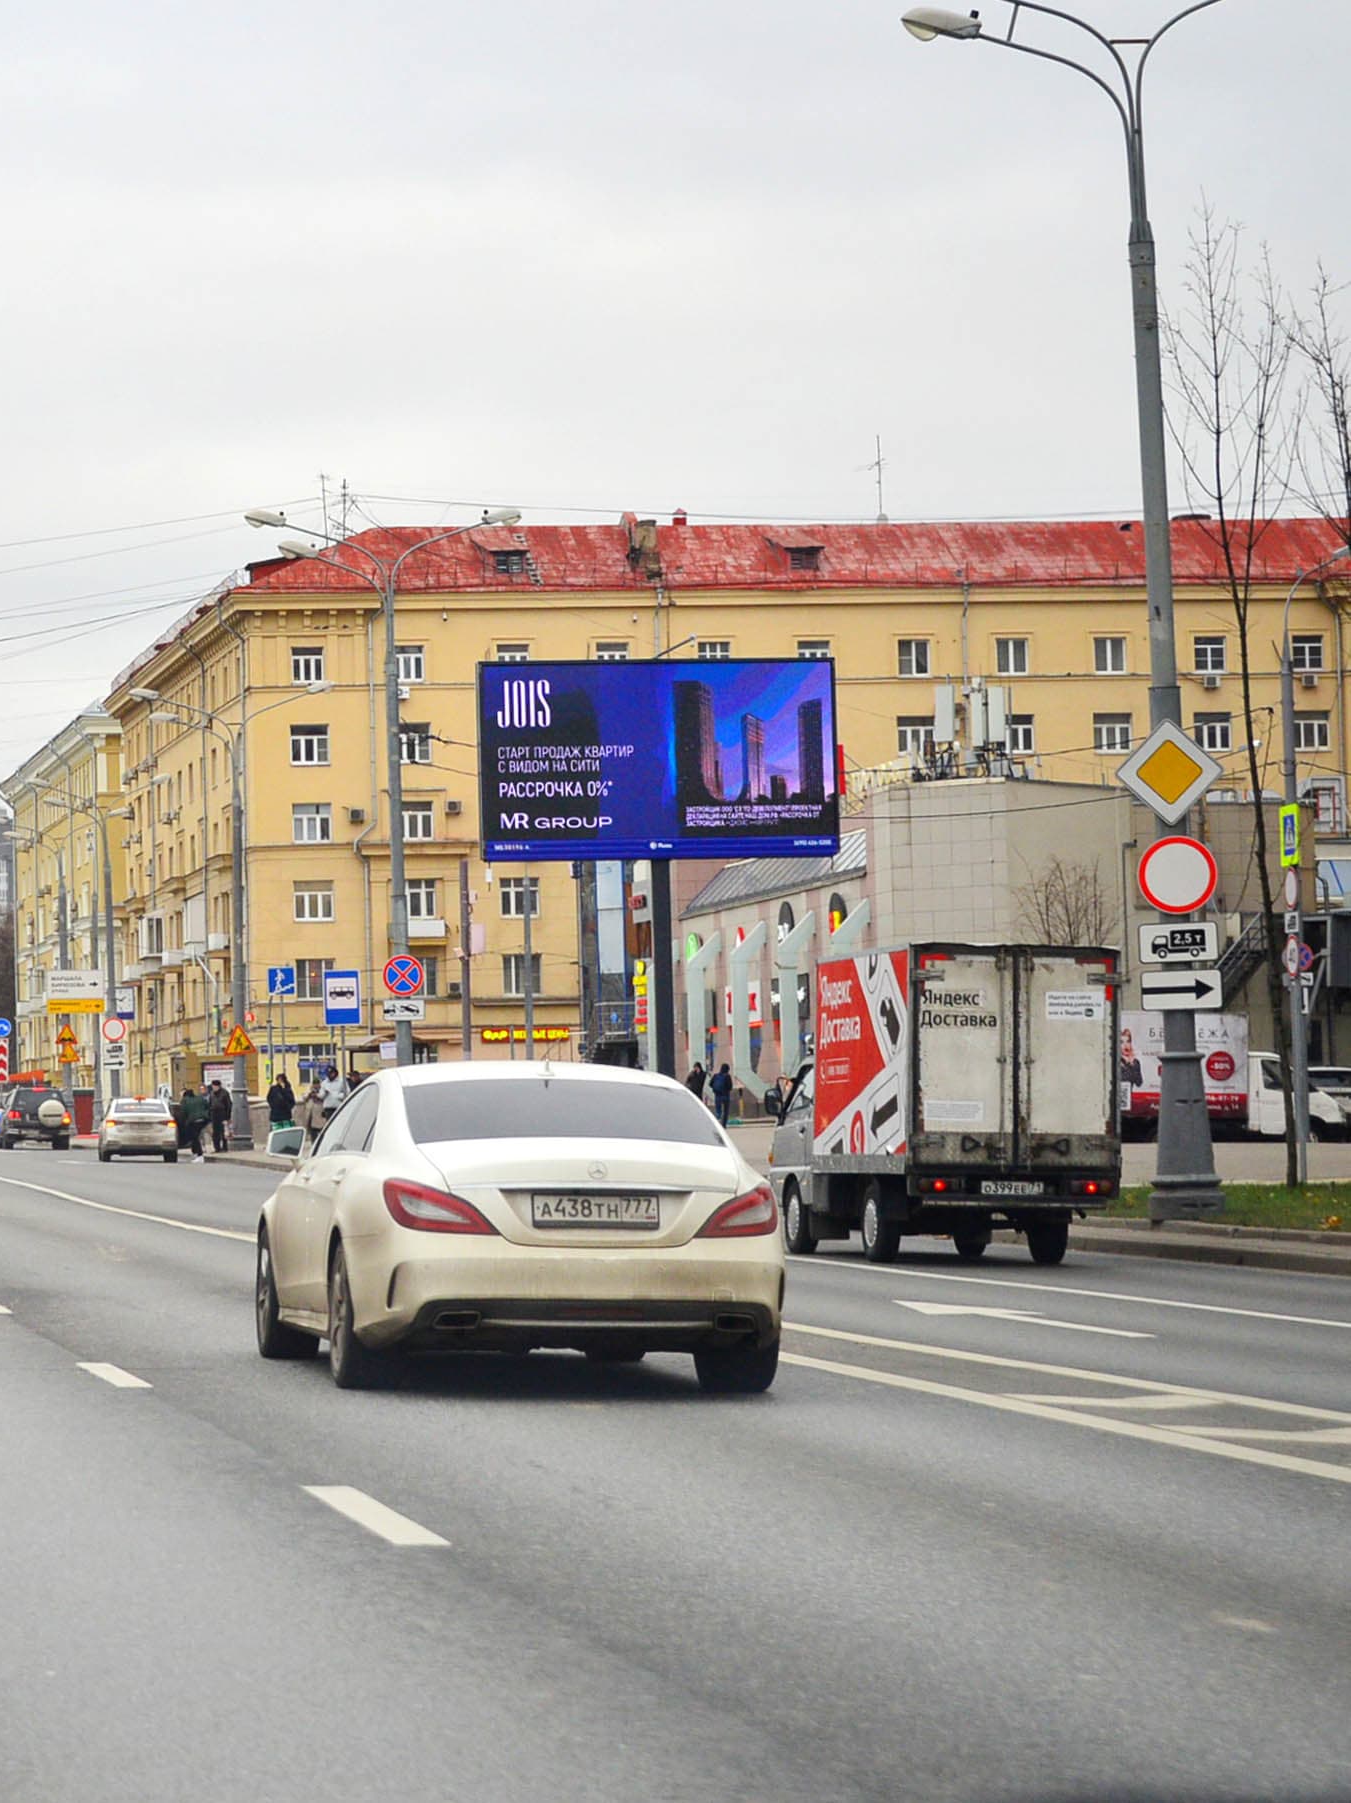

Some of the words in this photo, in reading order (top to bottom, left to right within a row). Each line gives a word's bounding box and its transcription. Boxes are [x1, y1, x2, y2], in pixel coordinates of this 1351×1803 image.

[497, 679, 550, 728] JOIS
[498, 746, 530, 760] СТАРТ
[534, 745, 582, 759] ПРОДАЖ
[585, 744, 634, 758] КВАРТИР
[498, 760, 506, 773] С
[509, 760, 549, 774] ВИДОМ
[552, 760, 568, 773] НА
[570, 759, 600, 772] СИТИ
[499, 782, 583, 798] РАССРОЧКА
[500, 813, 529, 829] MR
[534, 816, 613, 829] GROUP
[1173, 932, 1193, 945] 2,5
[820, 975, 853, 1010] Яндекс
[922, 990, 980, 1007] Яндекс
[921, 1010, 998, 1028] Доставка
[819, 1012, 862, 1050] Доставка
[621, 1198, 652, 1214] 777
